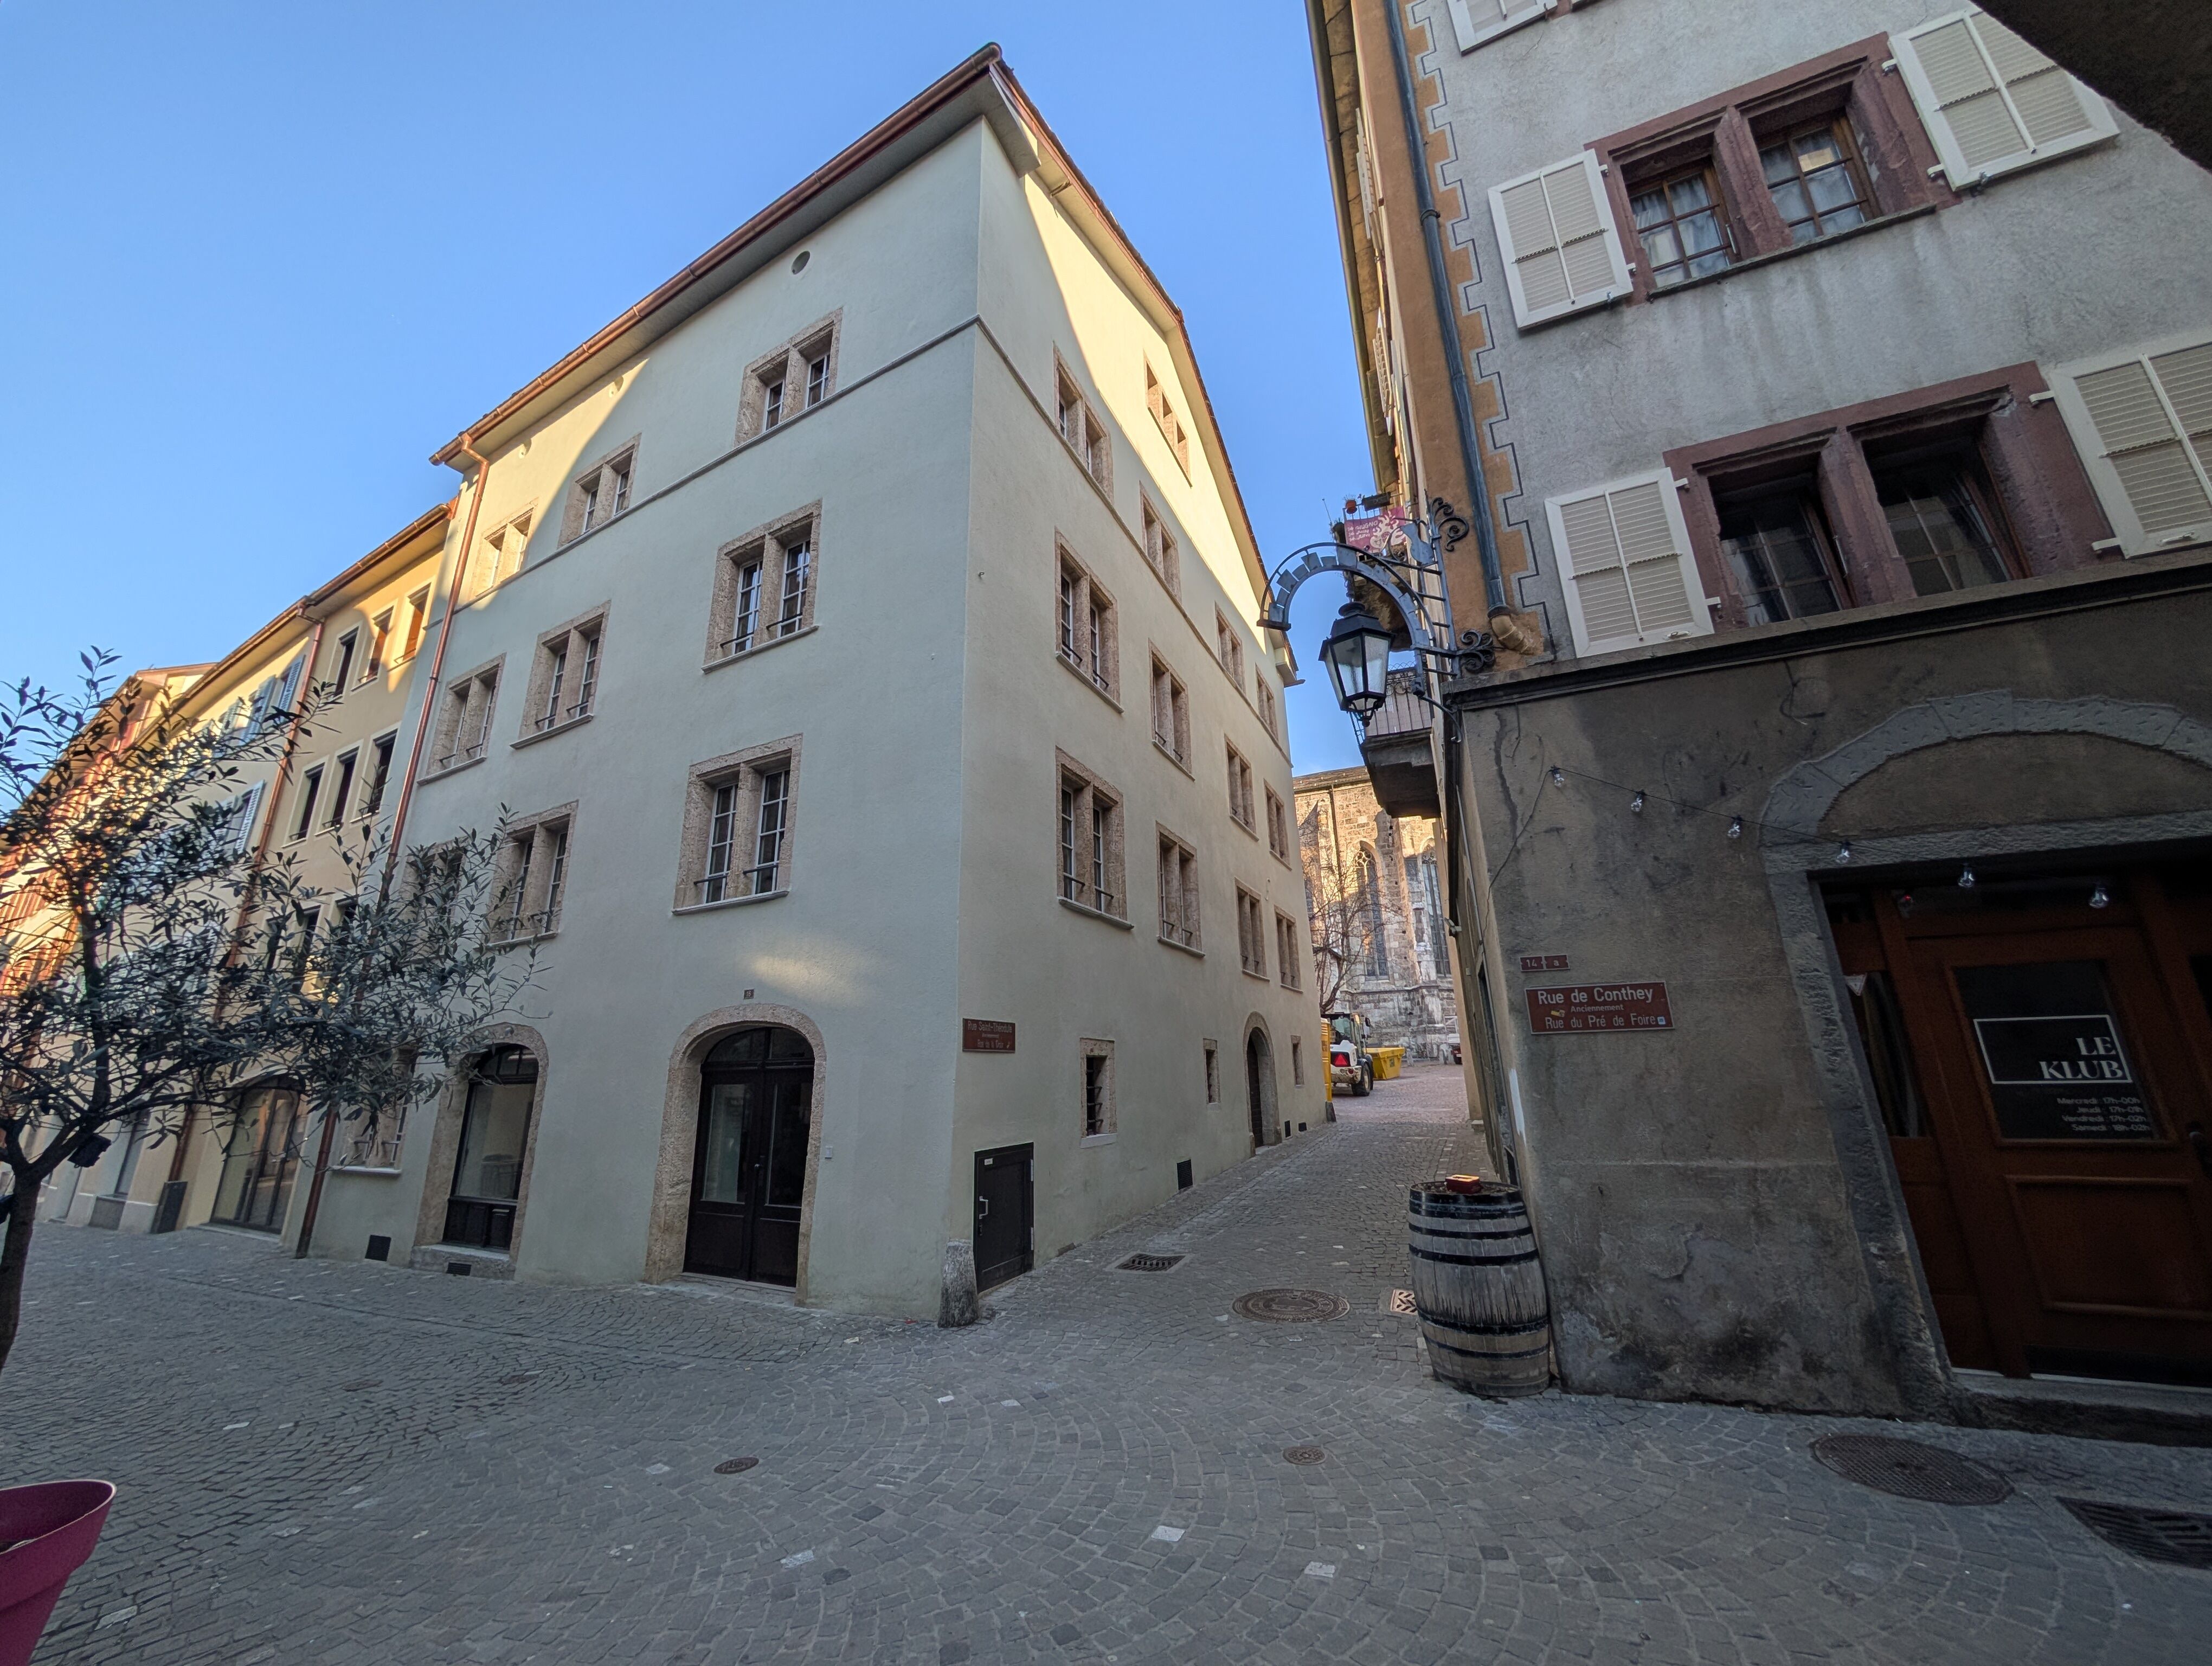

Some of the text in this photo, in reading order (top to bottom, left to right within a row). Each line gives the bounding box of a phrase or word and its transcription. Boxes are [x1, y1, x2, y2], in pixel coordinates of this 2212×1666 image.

[1355, 520, 1378, 530] GIUGNO
[1526, 959, 1538, 967] 14
[1538, 986, 1653, 1005] Rue de Conthey
[1571, 1004, 1624, 1013] Anciennement
[968, 1020, 977, 1030] Rue
[1545, 1013, 1656, 1029] Rue du Pré de Foire
[2075, 1036, 2116, 1055] LE
[2039, 1060, 2123, 1079] KLUB
